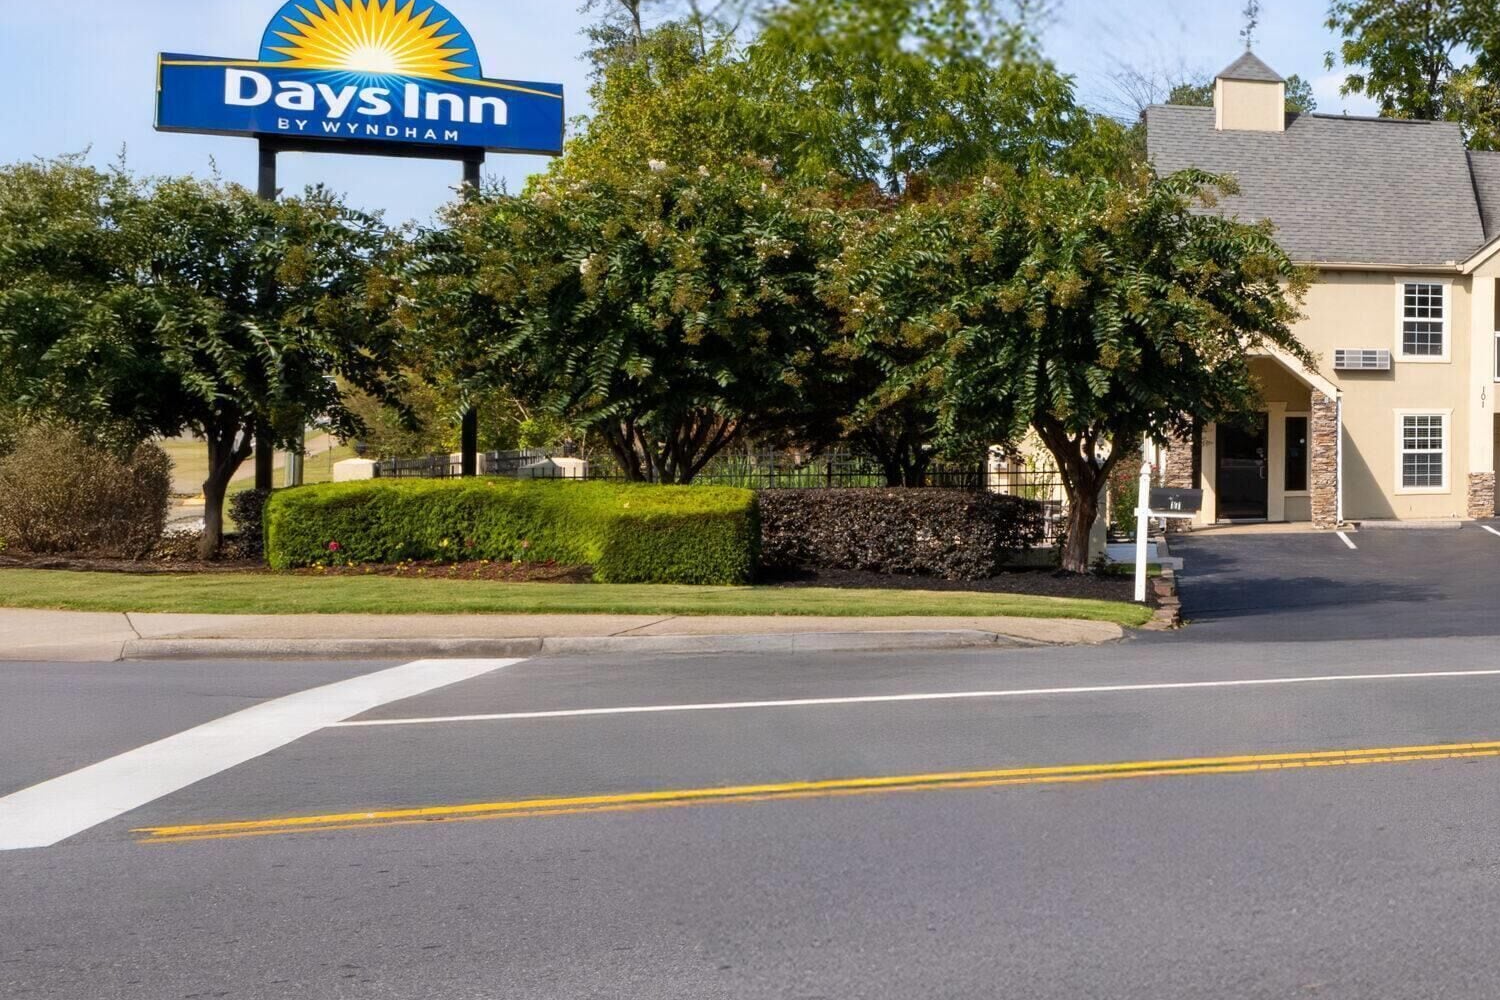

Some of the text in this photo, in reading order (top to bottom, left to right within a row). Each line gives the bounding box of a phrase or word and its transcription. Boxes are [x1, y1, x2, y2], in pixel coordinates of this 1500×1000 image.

[224, 68, 508, 125] Days Inn
[277, 118, 459, 142] BY WYNDHAM
